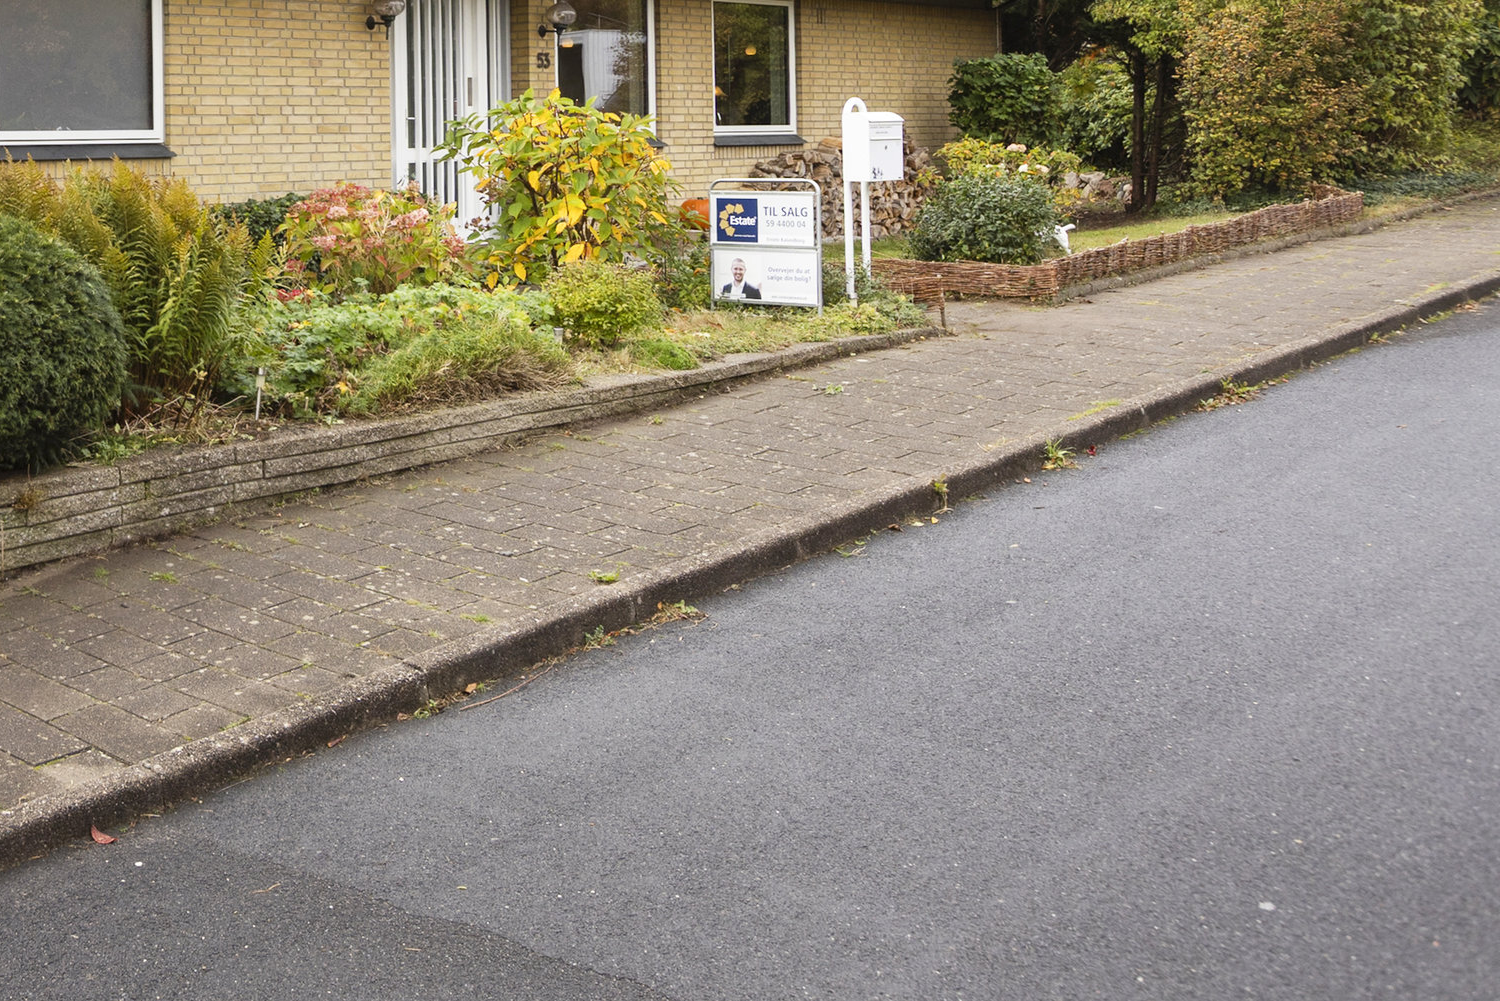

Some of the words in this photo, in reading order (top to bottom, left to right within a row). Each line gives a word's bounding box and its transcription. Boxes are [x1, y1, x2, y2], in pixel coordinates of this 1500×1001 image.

[536, 52, 551, 69] 53
[763, 206, 778, 217] TIL
[781, 206, 808, 218] SALG
[729, 215, 756, 226] Estate
[765, 219, 775, 228] 59
[777, 220, 795, 228] 4400
[796, 220, 806, 228] 04
